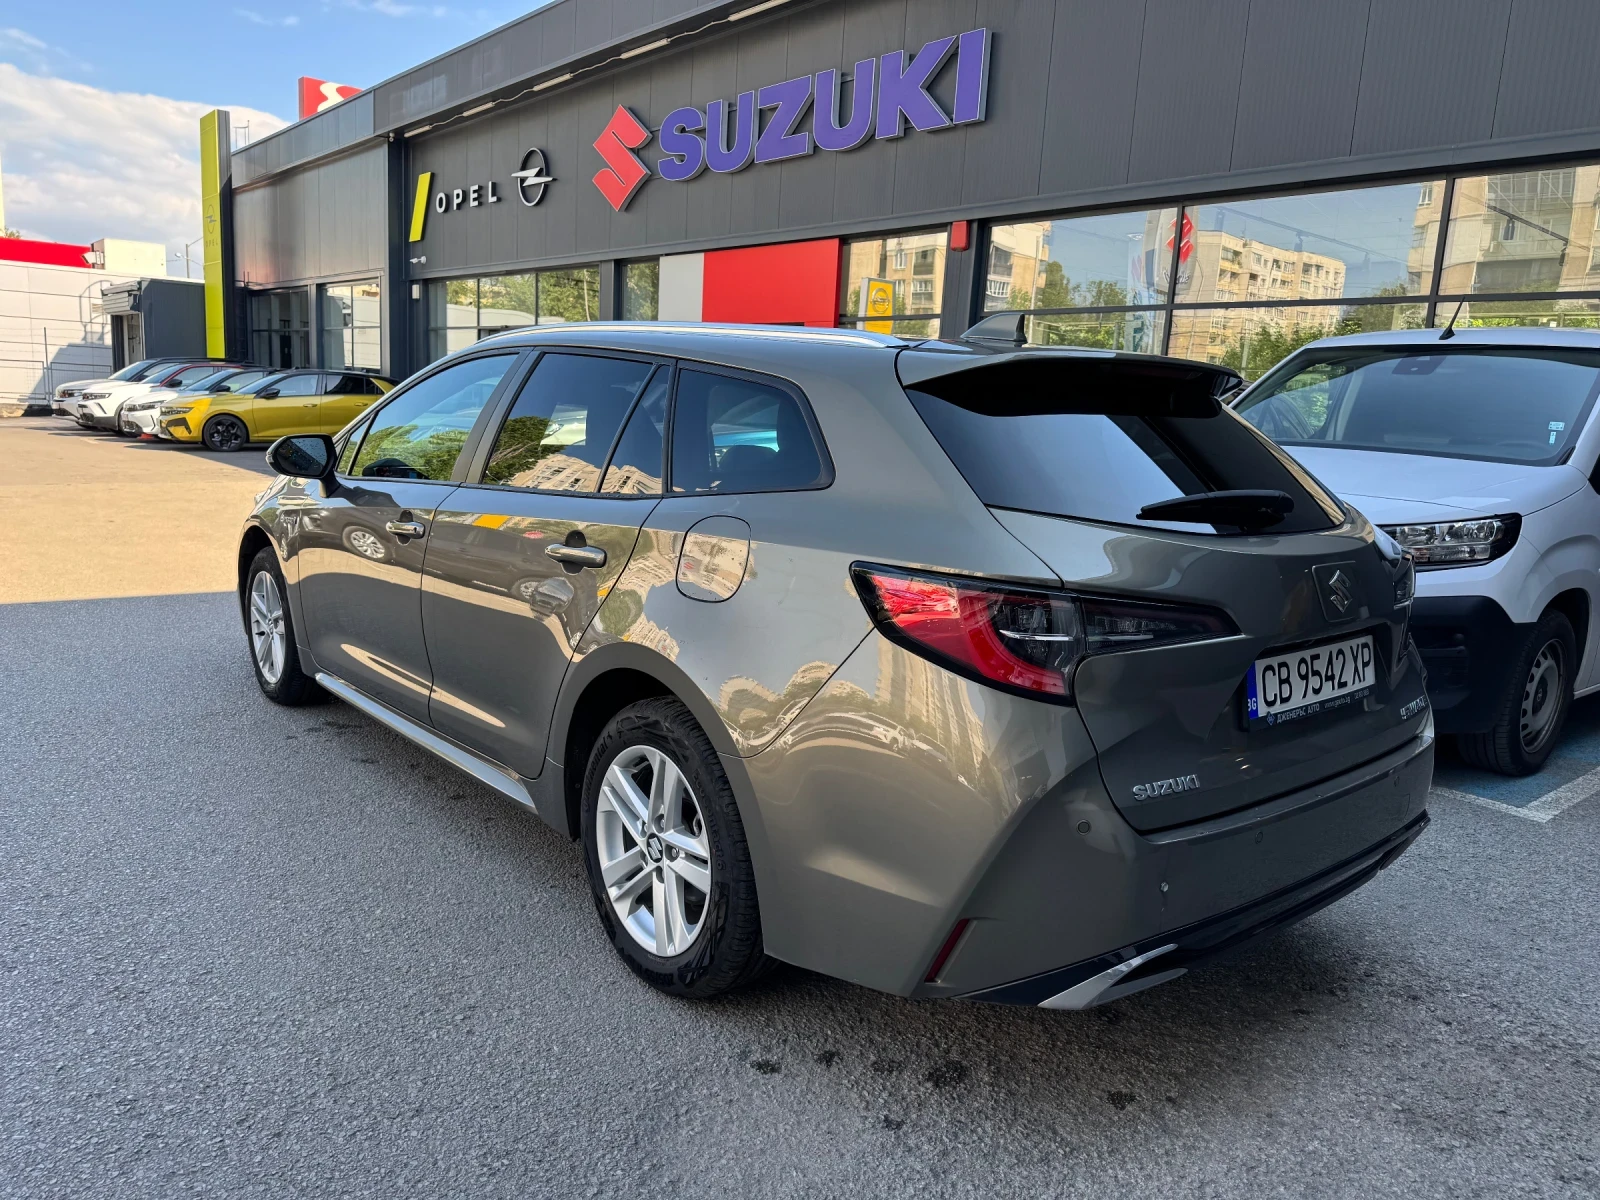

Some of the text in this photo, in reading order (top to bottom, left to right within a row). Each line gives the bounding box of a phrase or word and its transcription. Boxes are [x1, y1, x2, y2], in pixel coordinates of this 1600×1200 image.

[658, 28, 992, 181] SUZUKI
[436, 181, 499, 213] OPEL
[205, 238, 219, 248] OPEL
[1262, 642, 1371, 707] CB 9542 XP
[1132, 774, 1200, 801] SUZUKI
[716, 859, 726, 871] 6
